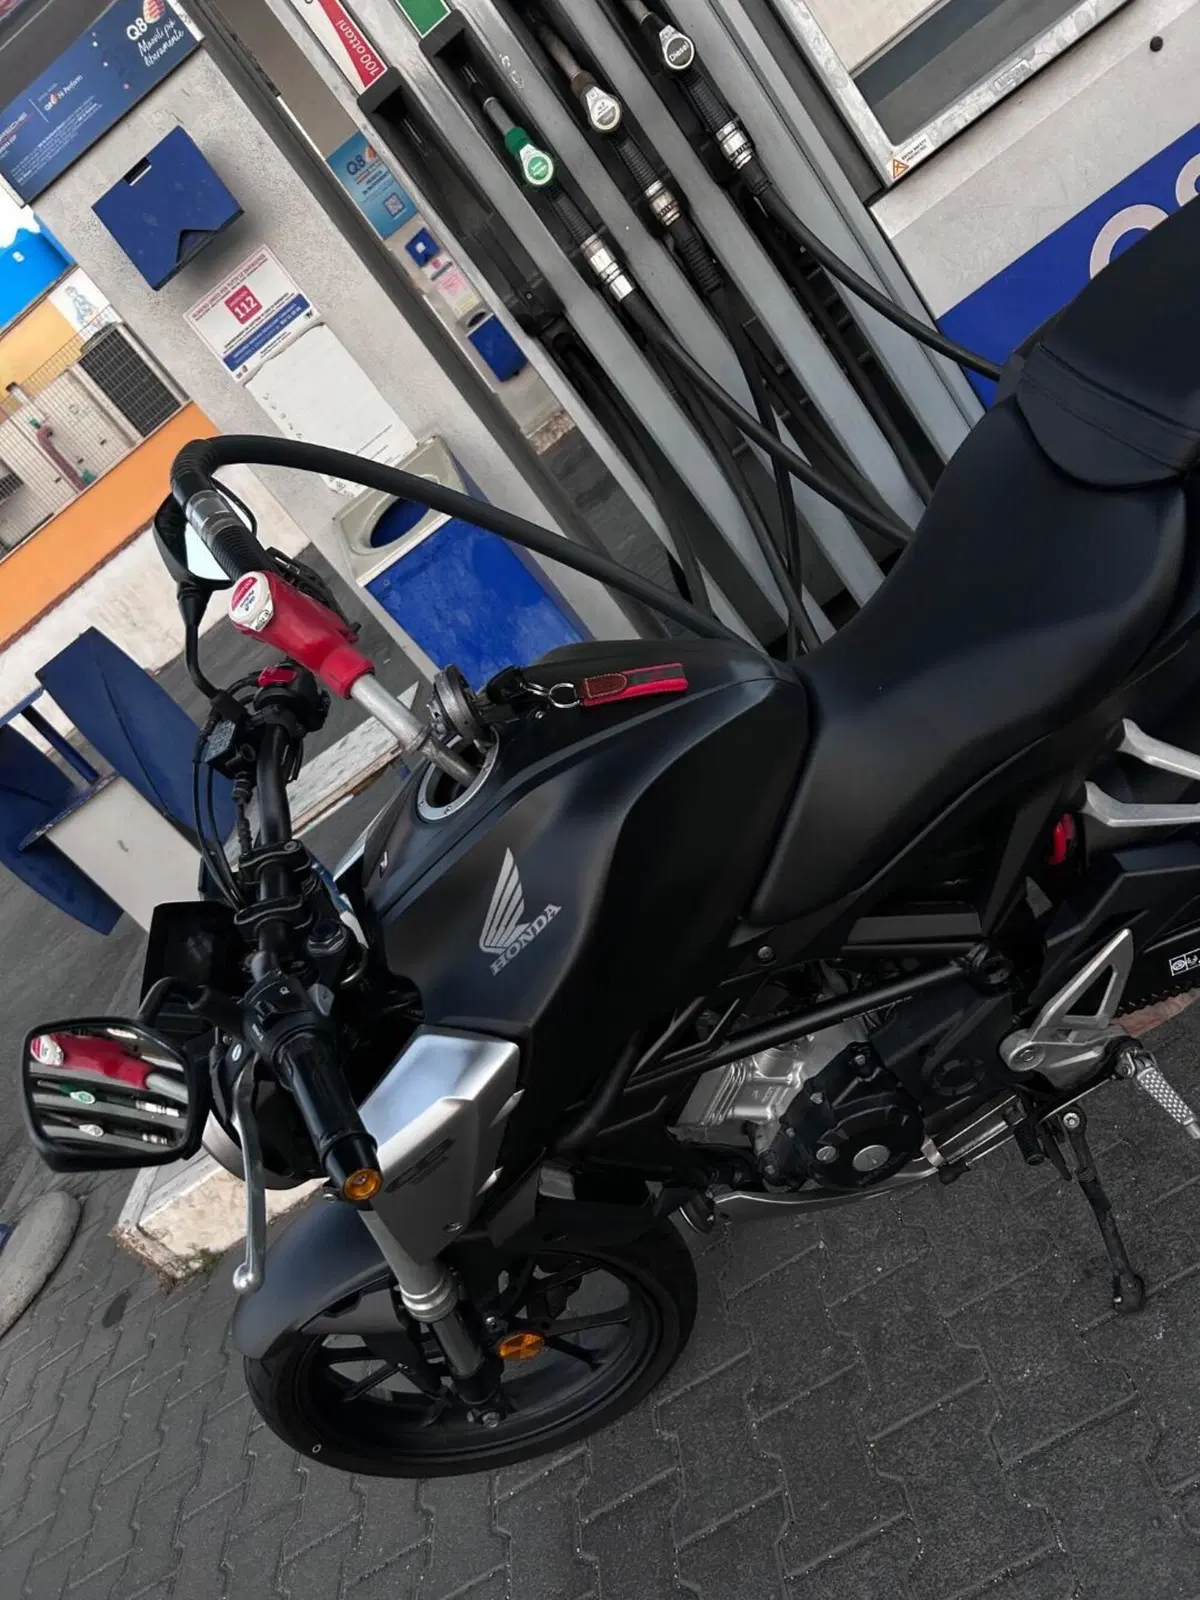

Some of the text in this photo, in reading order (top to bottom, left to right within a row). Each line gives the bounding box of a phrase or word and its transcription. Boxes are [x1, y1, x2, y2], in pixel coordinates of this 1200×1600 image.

[126, 17, 147, 40] Q8
[335, 19, 380, 77] 100 ottani
[669, 41, 690, 62] Diesel
[347, 155, 366, 176] Q8
[234, 296, 258, 318] 112
[490, 904, 562, 976] HONDA
